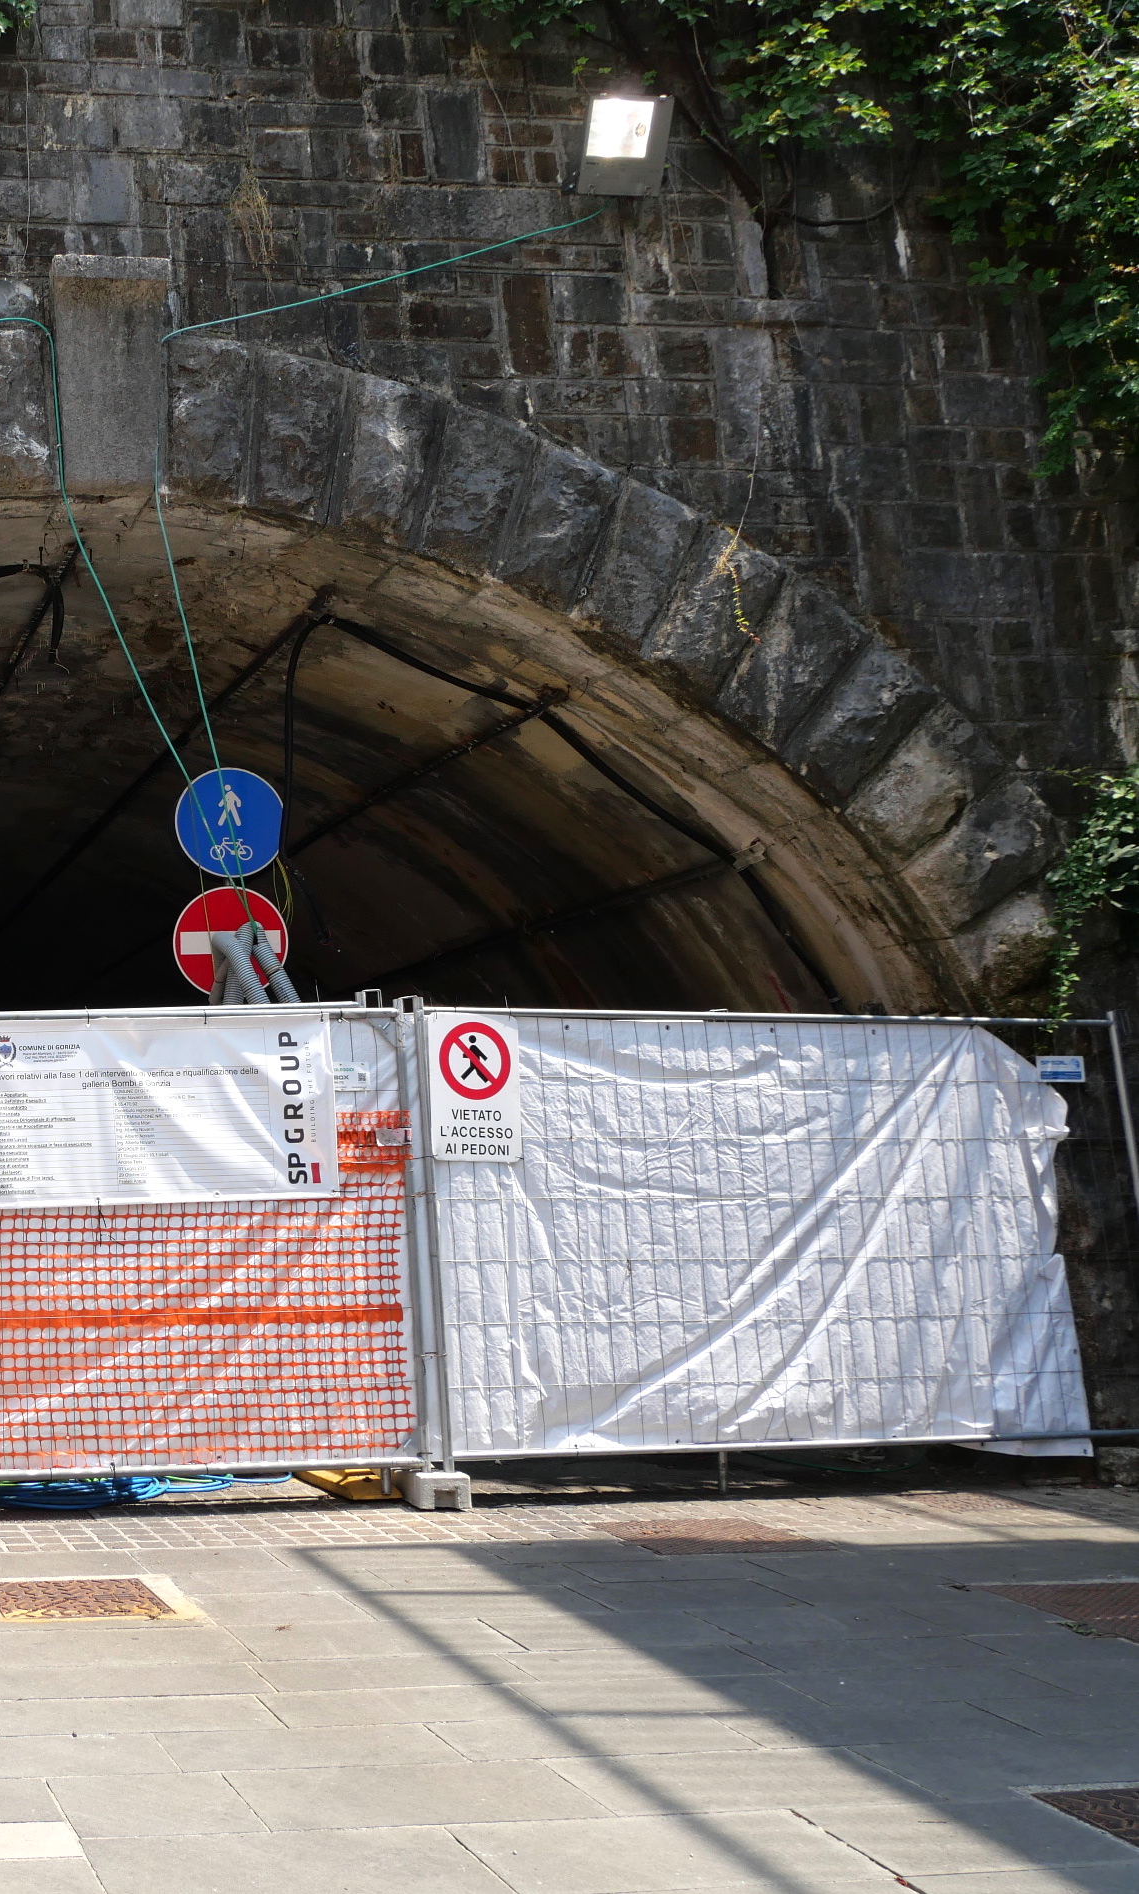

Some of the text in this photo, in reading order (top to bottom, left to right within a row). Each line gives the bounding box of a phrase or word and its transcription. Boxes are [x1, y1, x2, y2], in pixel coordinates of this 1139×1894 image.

[304, 1041, 312, 1074] FUTURE
[183, 1068, 238, 1077] riqualificazione
[82, 1080, 109, 1089] galleria
[278, 1031, 308, 1184] SP GROUP
[451, 1109, 502, 1121] VIETATO
[440, 1126, 513, 1139] L'ACCESSO
[445, 1143, 509, 1156] AI PEDONI
